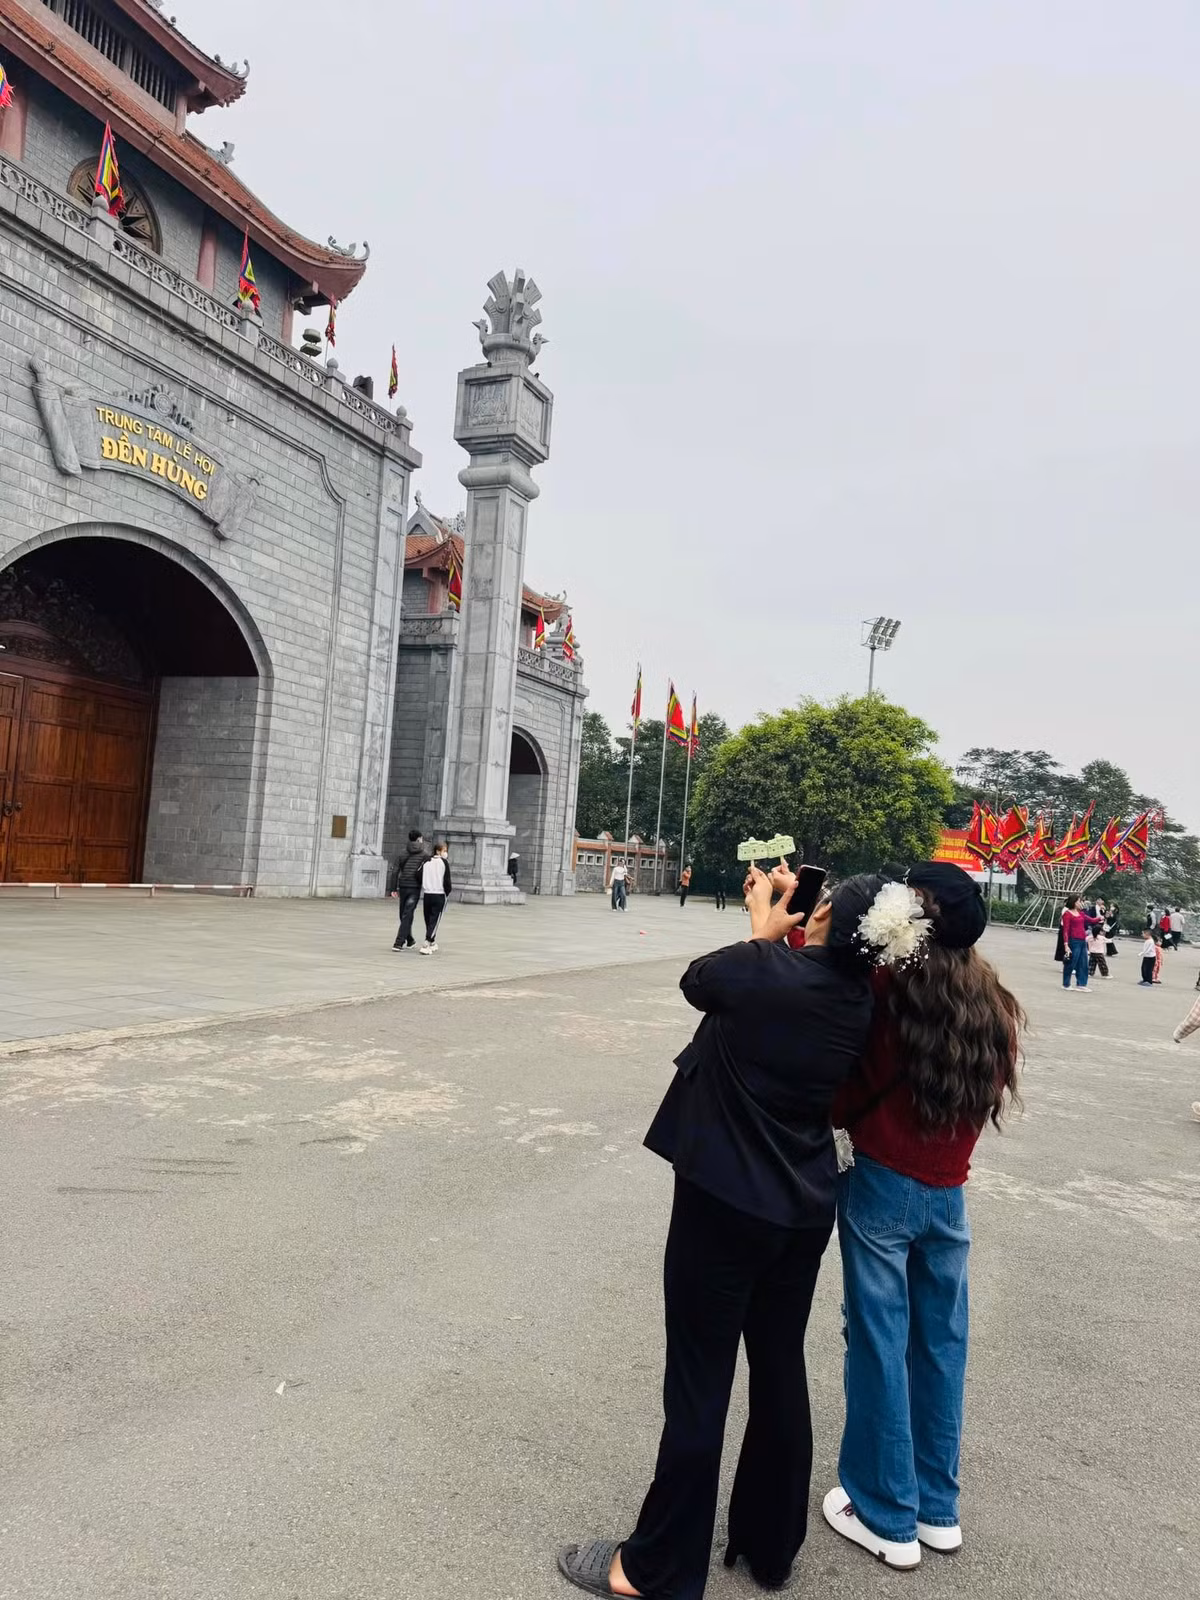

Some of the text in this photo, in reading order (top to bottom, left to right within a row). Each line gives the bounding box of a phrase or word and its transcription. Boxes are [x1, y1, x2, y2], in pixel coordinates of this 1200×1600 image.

[96, 406, 216, 476] TRUNG TÂM LỄ HỘI
[101, 430, 208, 500] ĐỀN HÙNG
